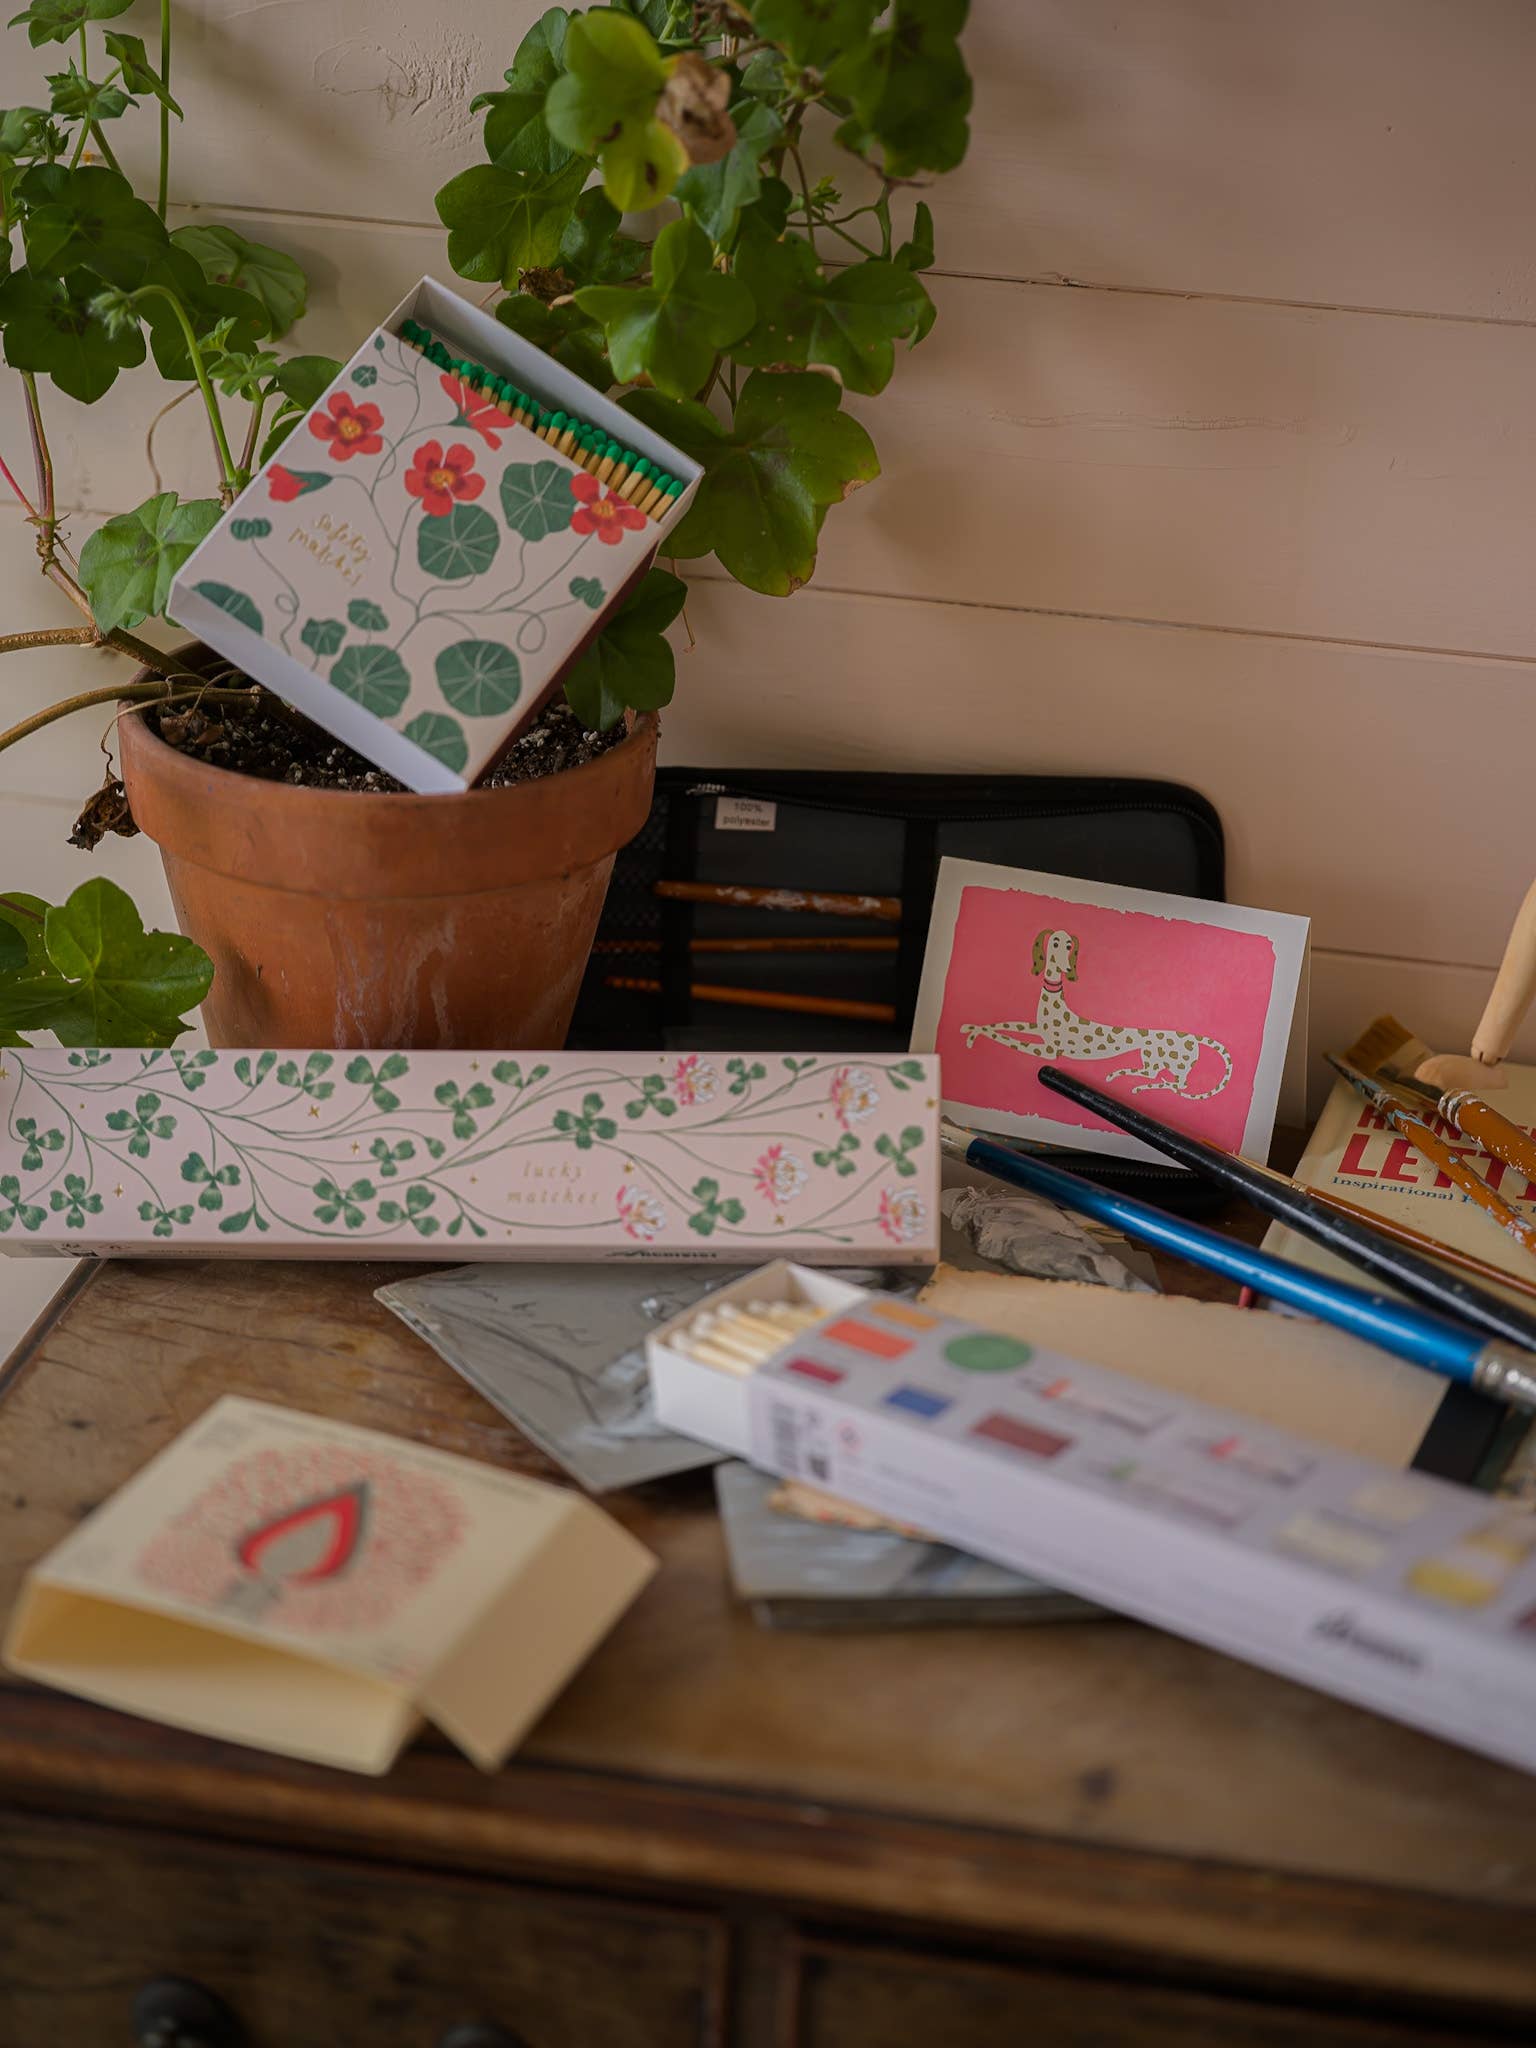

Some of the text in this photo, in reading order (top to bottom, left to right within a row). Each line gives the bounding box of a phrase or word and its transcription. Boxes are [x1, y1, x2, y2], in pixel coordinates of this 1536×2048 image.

[522, 1160, 583, 1182] lucky
[507, 1187, 599, 1204] matches
[1331, 1175, 1454, 1201] Inspirational
